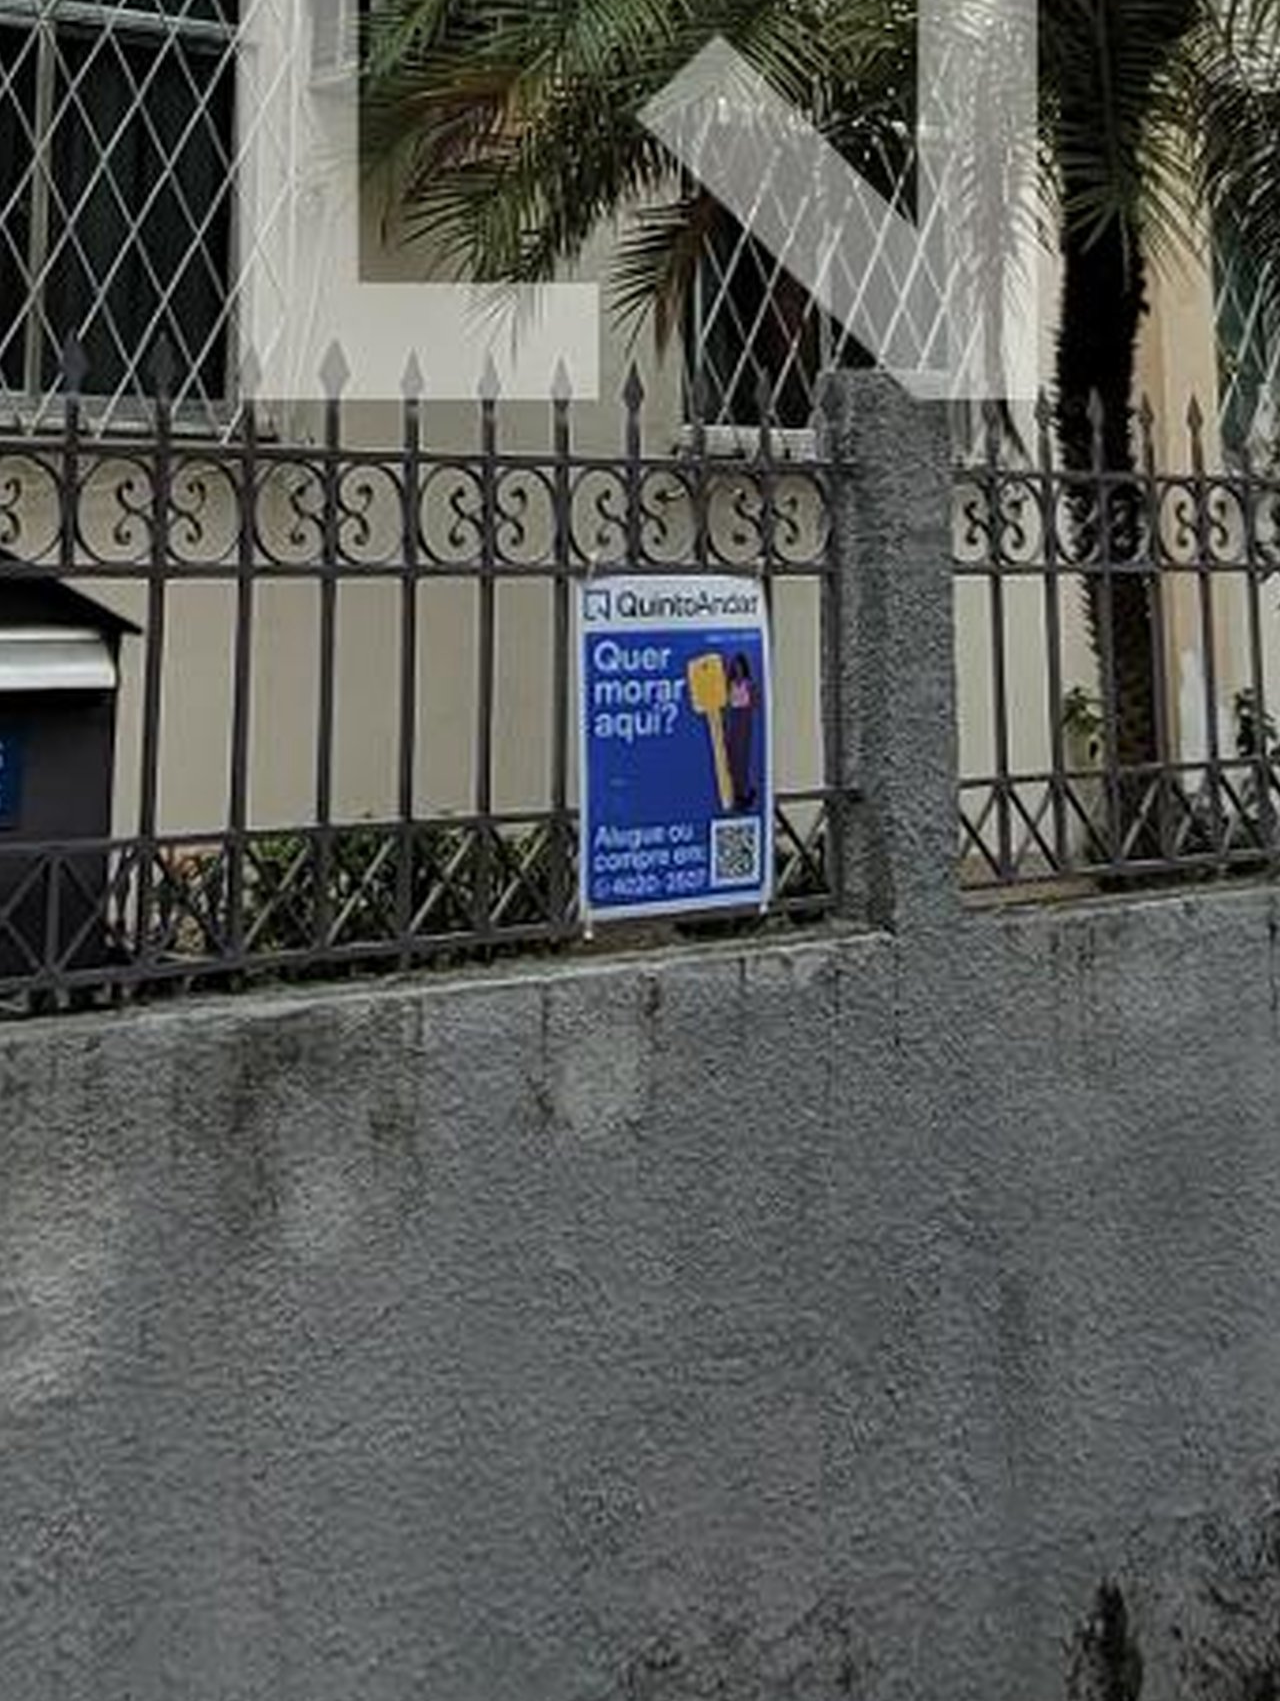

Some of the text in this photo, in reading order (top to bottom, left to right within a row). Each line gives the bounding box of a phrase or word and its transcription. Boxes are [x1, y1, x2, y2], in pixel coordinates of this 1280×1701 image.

[593, 639, 671, 674] Quer
[594, 677, 685, 705] morar
[593, 703, 679, 745] aqui?
